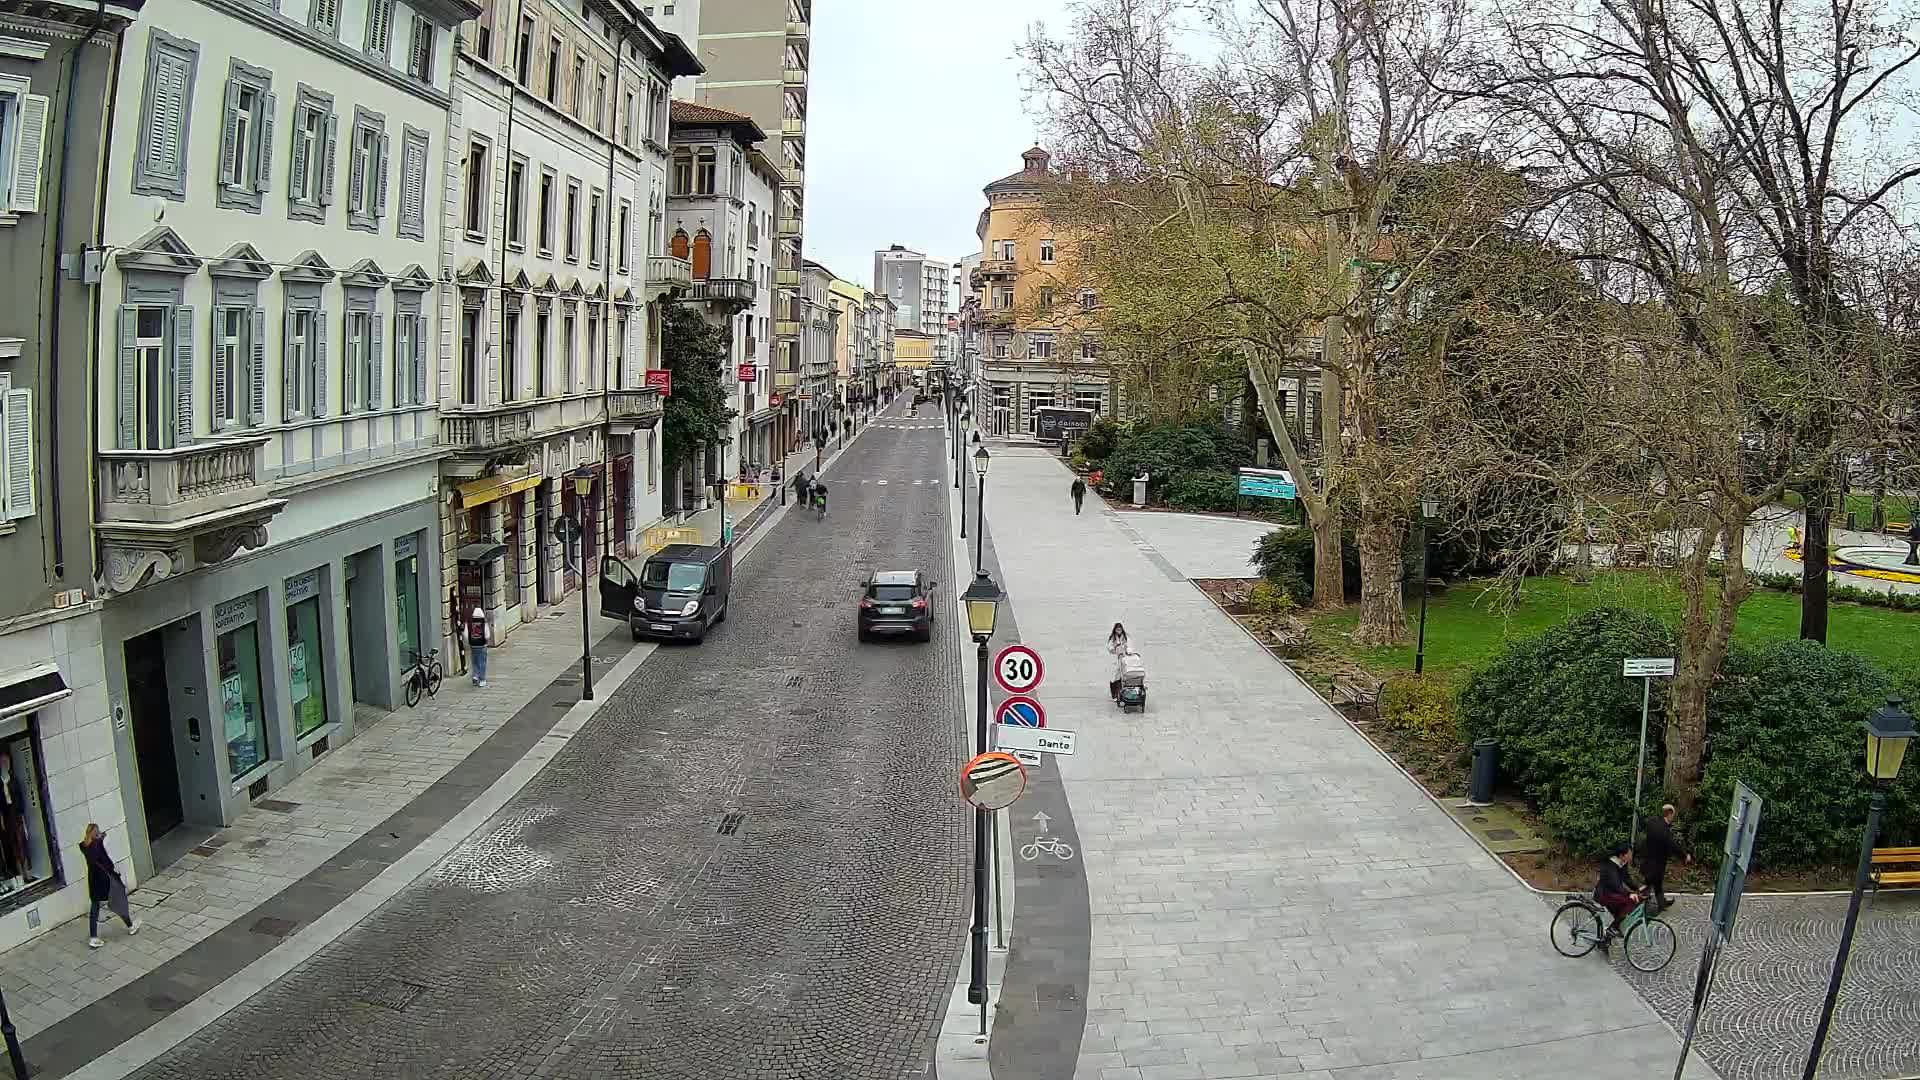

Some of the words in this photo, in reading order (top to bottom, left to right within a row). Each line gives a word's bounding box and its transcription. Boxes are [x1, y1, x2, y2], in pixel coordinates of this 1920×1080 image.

[1005, 658, 1033, 681] 30
[222, 678, 241, 701] 130
[1038, 738, 1070, 750] Dante
